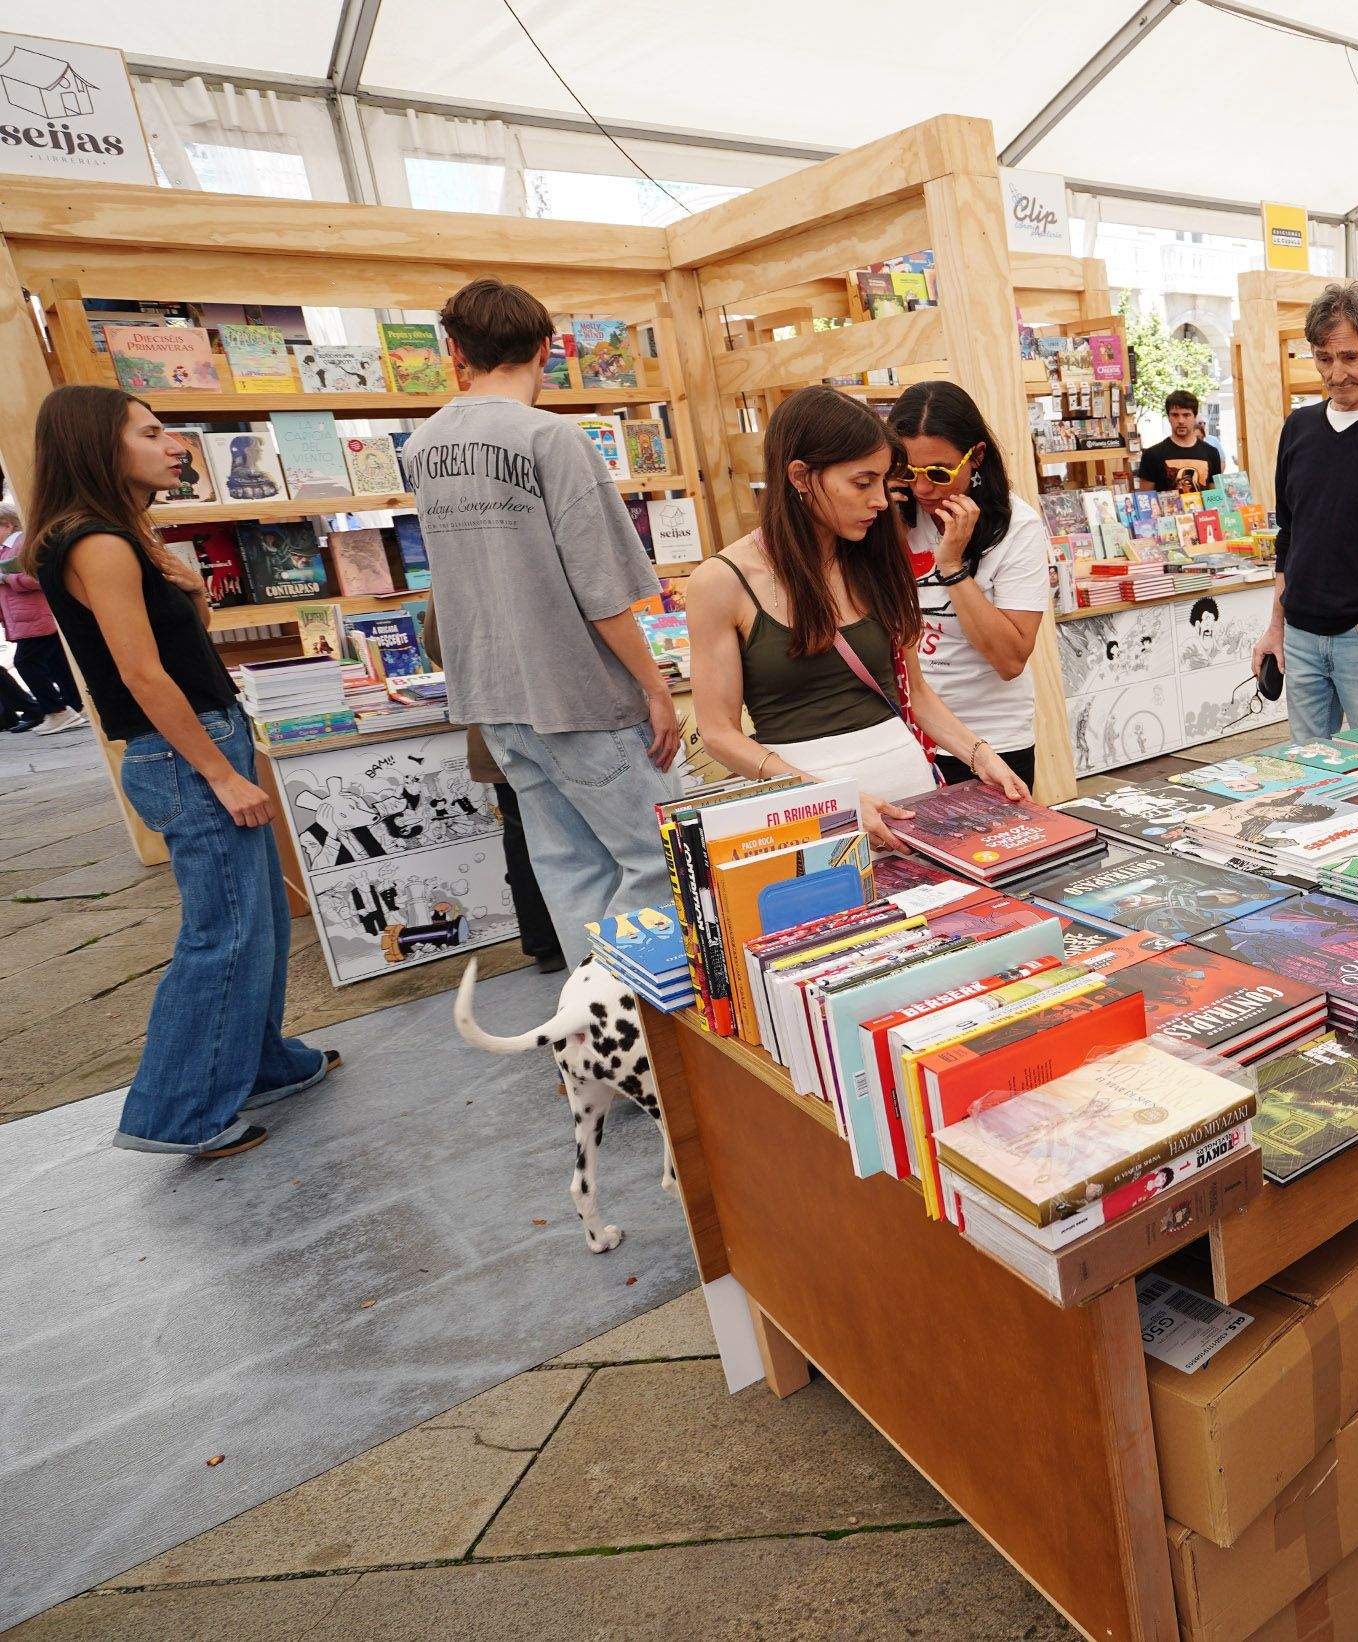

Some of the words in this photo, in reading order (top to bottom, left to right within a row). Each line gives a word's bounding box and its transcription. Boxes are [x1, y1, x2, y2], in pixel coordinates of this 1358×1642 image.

[0, 122, 124, 155] seijas
[1014, 196, 1057, 234] Clip
[127, 341, 194, 353] PRIMAVERAS
[427, 443, 479, 479] GREAT
[481, 443, 542, 499] TIMES
[660, 527, 692, 539] seijas
[265, 583, 320, 597] CONTRAPASO
[365, 755, 396, 779] BAM!!
[741, 840, 758, 850] PACO
[758, 836, 775, 847] ROCA
[1063, 858, 1166, 896] CONTRAPASO
[900, 980, 989, 1018] BERSERK
[1170, 1129, 1202, 1157] HAYAO
[1204, 1104, 1249, 1139] MIYAZAKI
[1196, 1141, 1236, 1169] TOKYO
